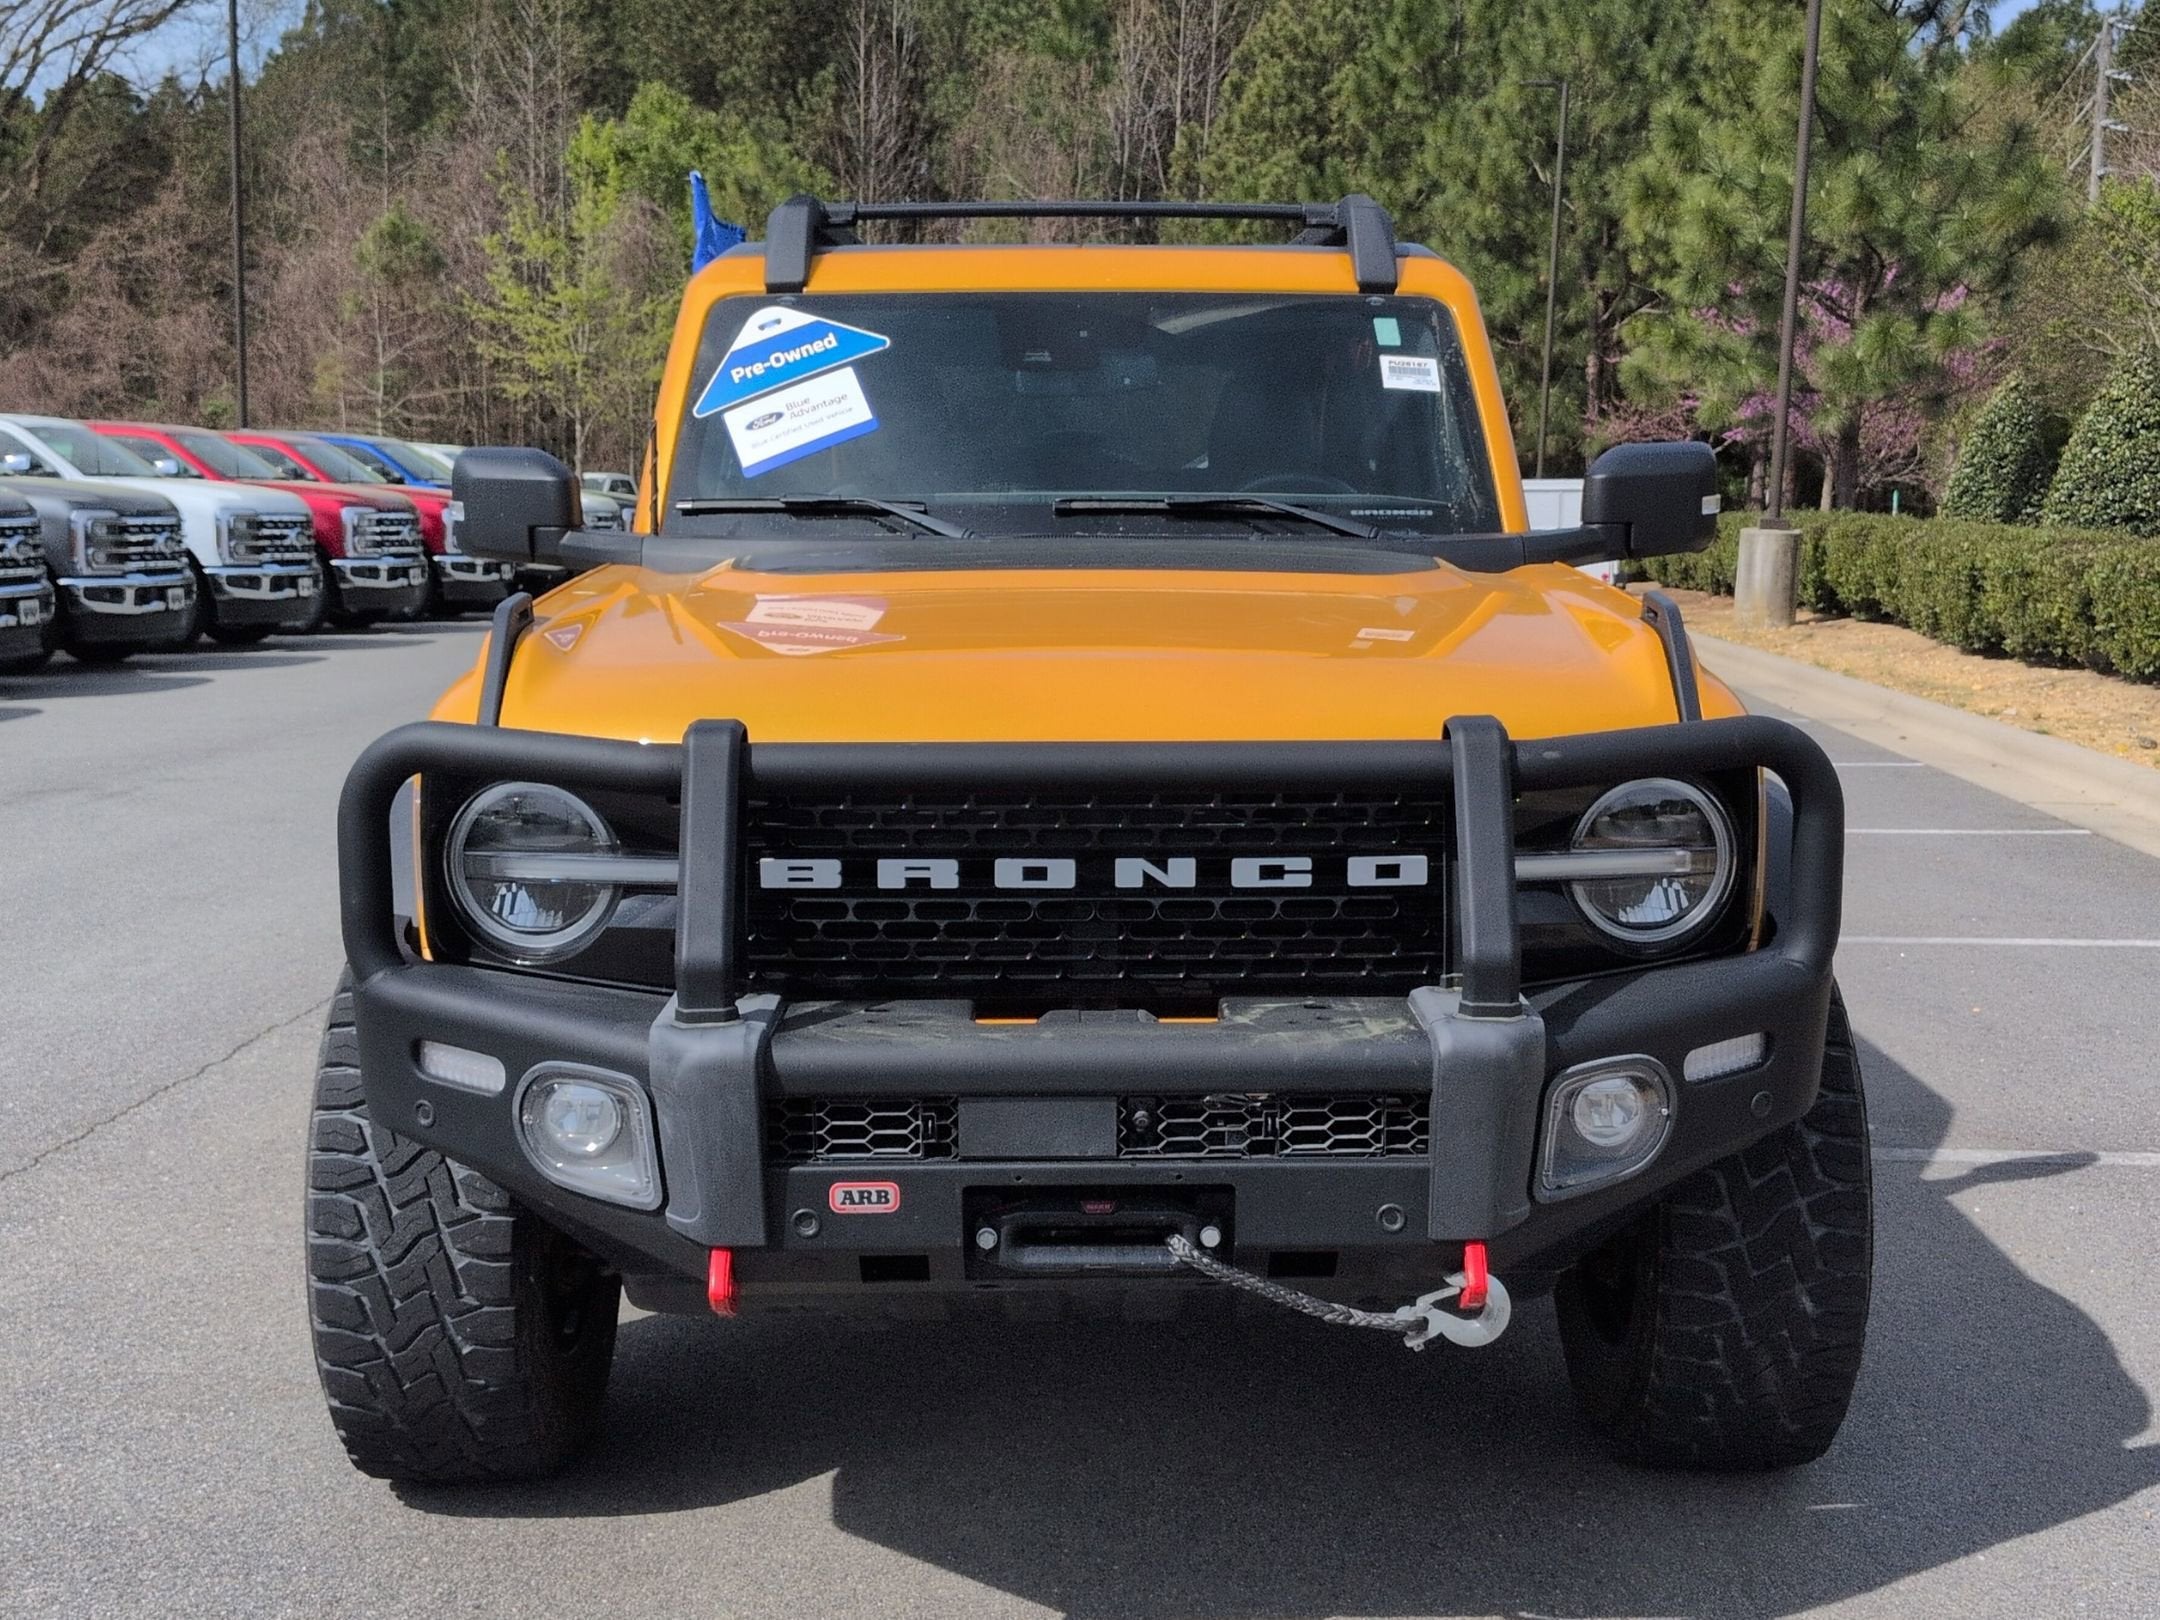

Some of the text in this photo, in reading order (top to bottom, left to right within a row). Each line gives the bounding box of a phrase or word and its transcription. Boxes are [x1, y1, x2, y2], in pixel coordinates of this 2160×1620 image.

[730, 332, 839, 383] Pre-Owned
[785, 397, 810, 411] Blue
[789, 393, 848, 420] Advantage
[749, 412, 780, 430] Ford
[759, 855, 1428, 889] BRONCO
[840, 1189, 890, 1205] ARB
